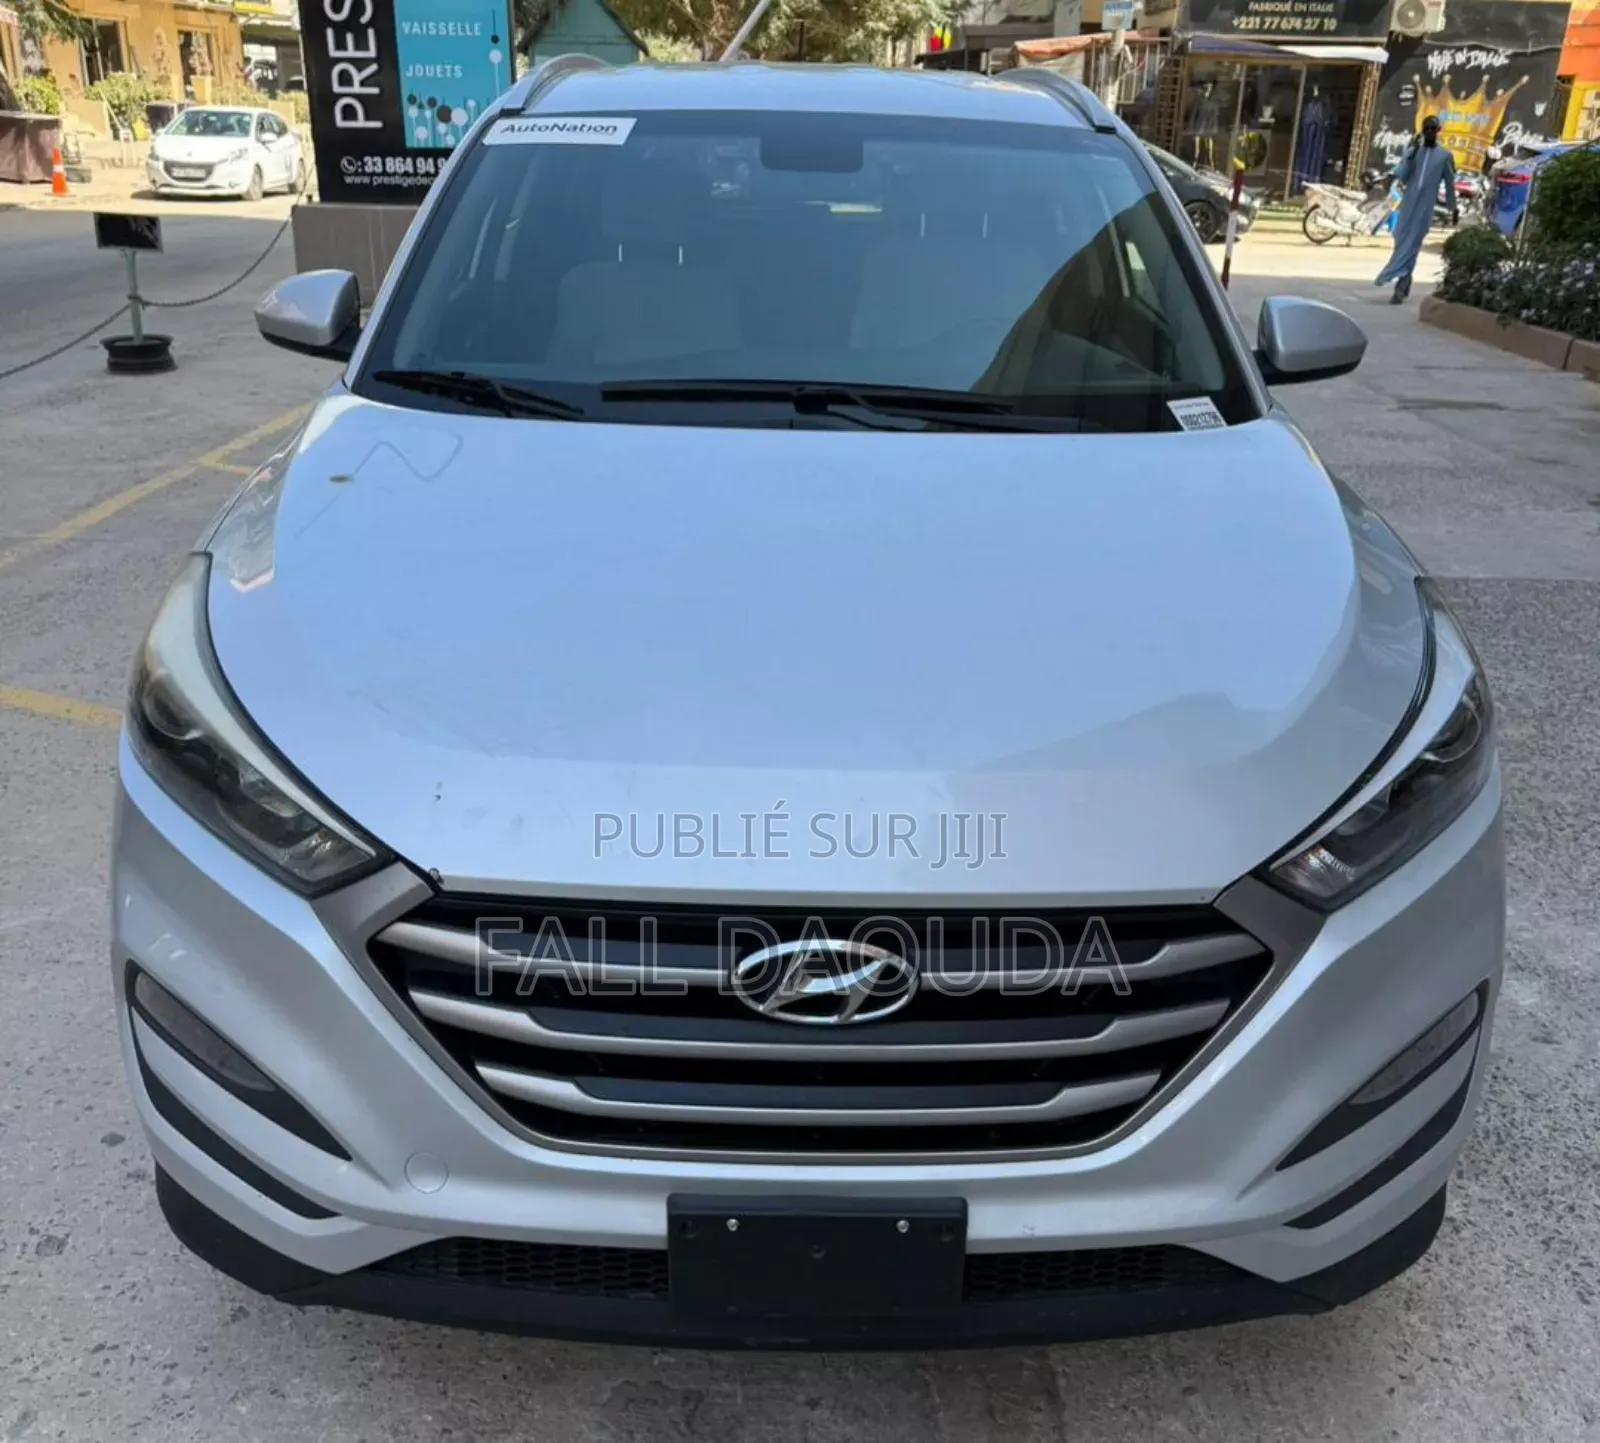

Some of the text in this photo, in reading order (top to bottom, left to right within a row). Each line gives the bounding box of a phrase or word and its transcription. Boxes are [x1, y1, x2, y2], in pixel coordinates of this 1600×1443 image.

[1294, 3, 1307, 13] EN
[1308, 3, 1334, 13] ITALIE
[402, 21, 482, 36] VAISSELLE
[1232, 16, 1338, 31] +221 77 674 27 10
[405, 63, 464, 78] JOUETS
[500, 122, 618, 135] AutoNation
[385, 156, 414, 174] 864
[416, 157, 435, 174] 94
